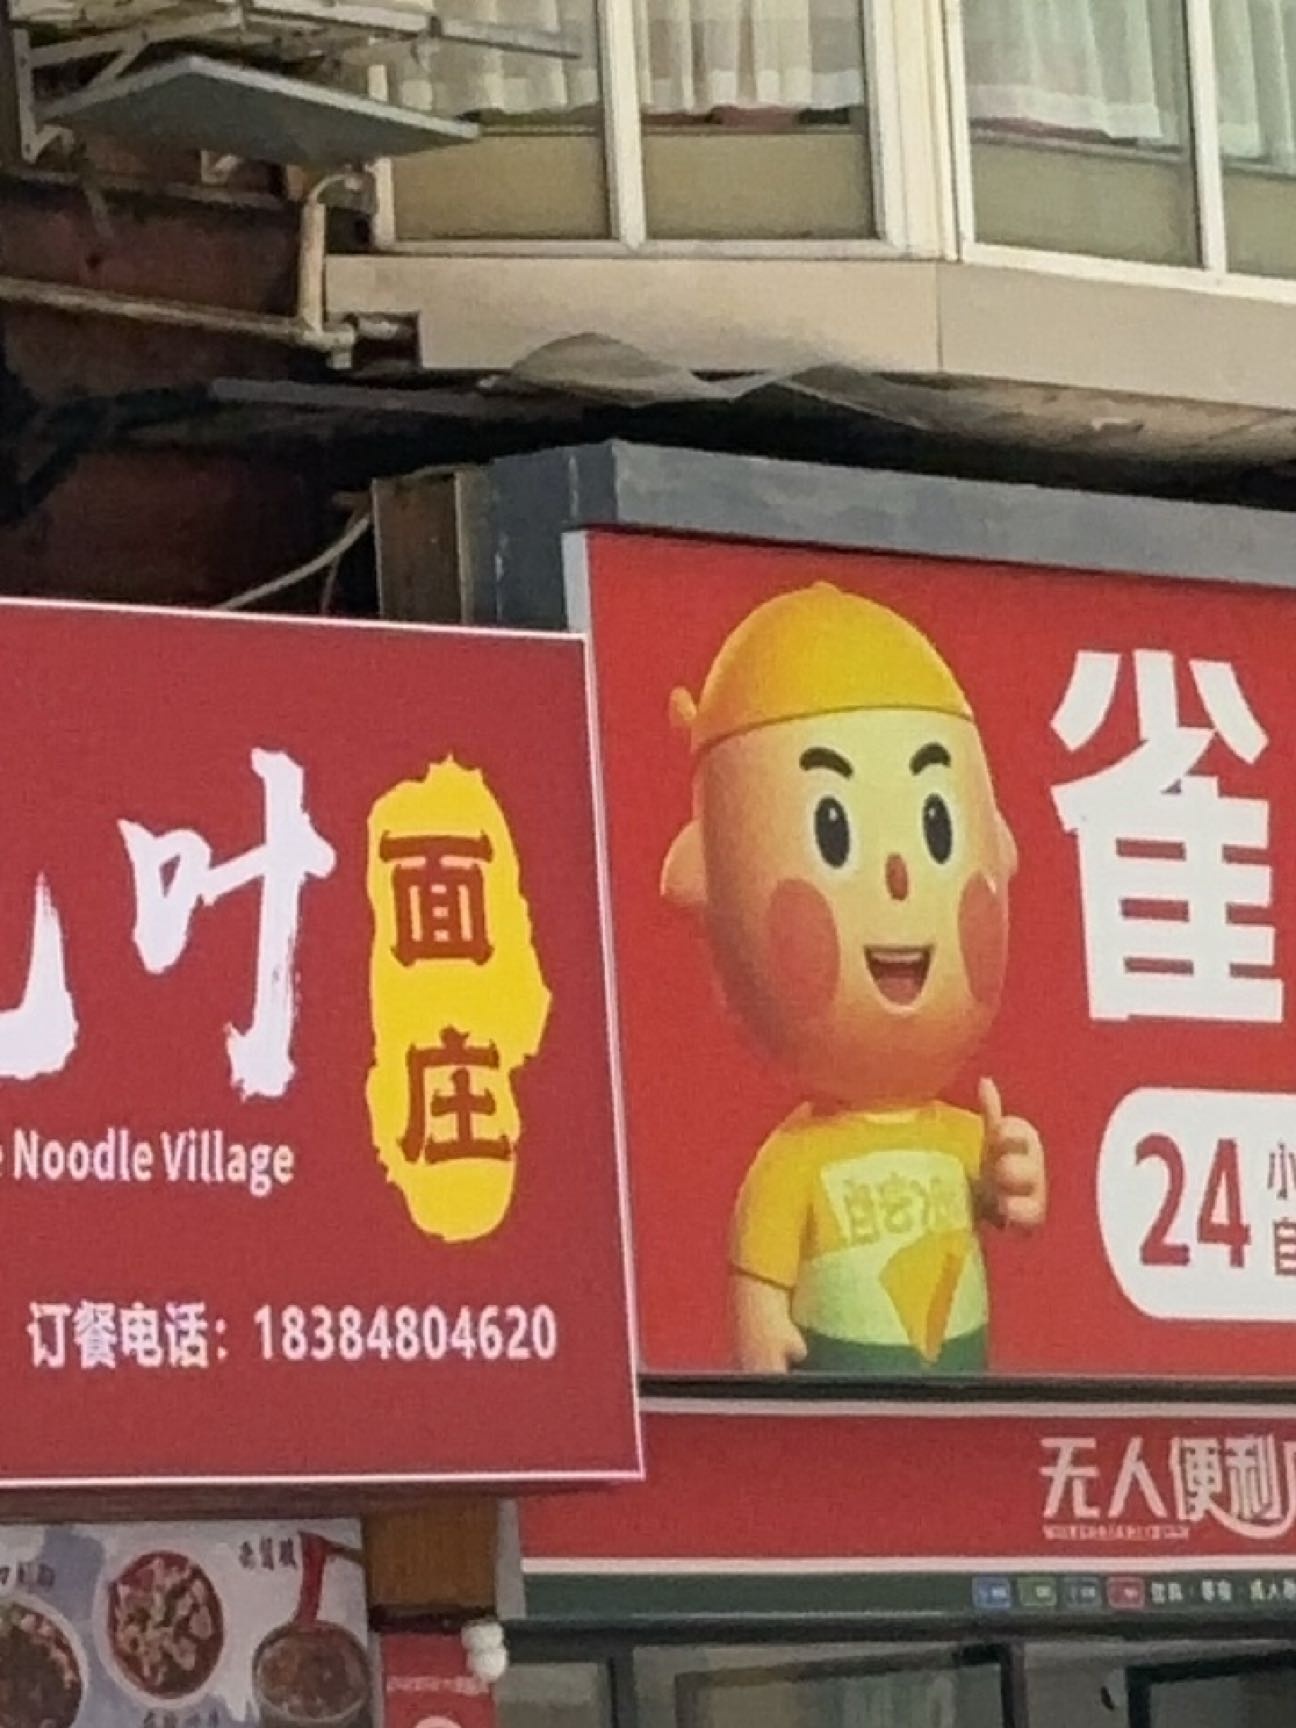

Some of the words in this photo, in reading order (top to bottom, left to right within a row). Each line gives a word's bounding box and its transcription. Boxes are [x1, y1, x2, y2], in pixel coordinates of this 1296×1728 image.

[379, 830, 514, 1165] 面庄
[13, 1126, 154, 1181] Noodle
[160, 1127, 295, 1197] Village
[1133, 1133, 1252, 1270] 24
